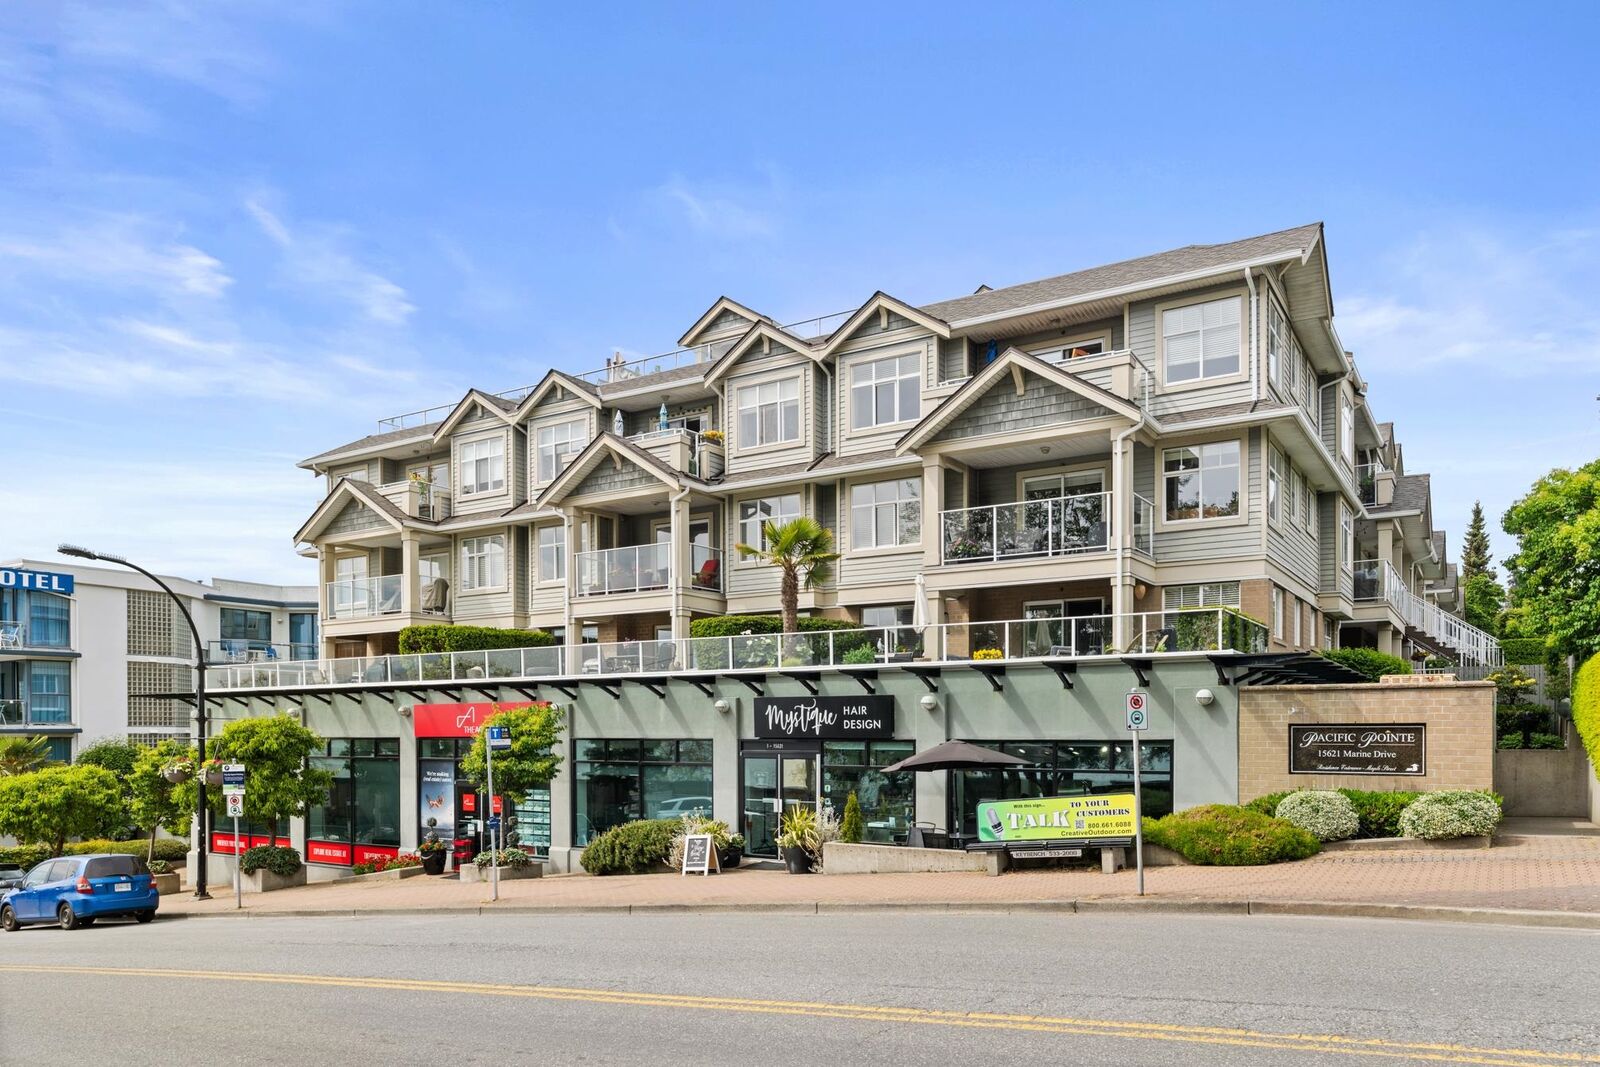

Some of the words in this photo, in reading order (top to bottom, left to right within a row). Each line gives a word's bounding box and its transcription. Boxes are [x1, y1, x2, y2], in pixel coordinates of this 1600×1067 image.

[843, 706, 867, 715] HAIR
[765, 698, 837, 735] Mystique
[843, 719, 881, 729] DESIGN
[1300, 732, 1356, 747] PACIFIC
[1358, 732, 1415, 748] POINTE
[1343, 750, 1371, 758] Marine
[1076, 808, 1130, 817] CUSTOMERS
[1007, 810, 1070, 829] TALK
[1061, 829, 1132, 837] CreativeOutdoor.com
